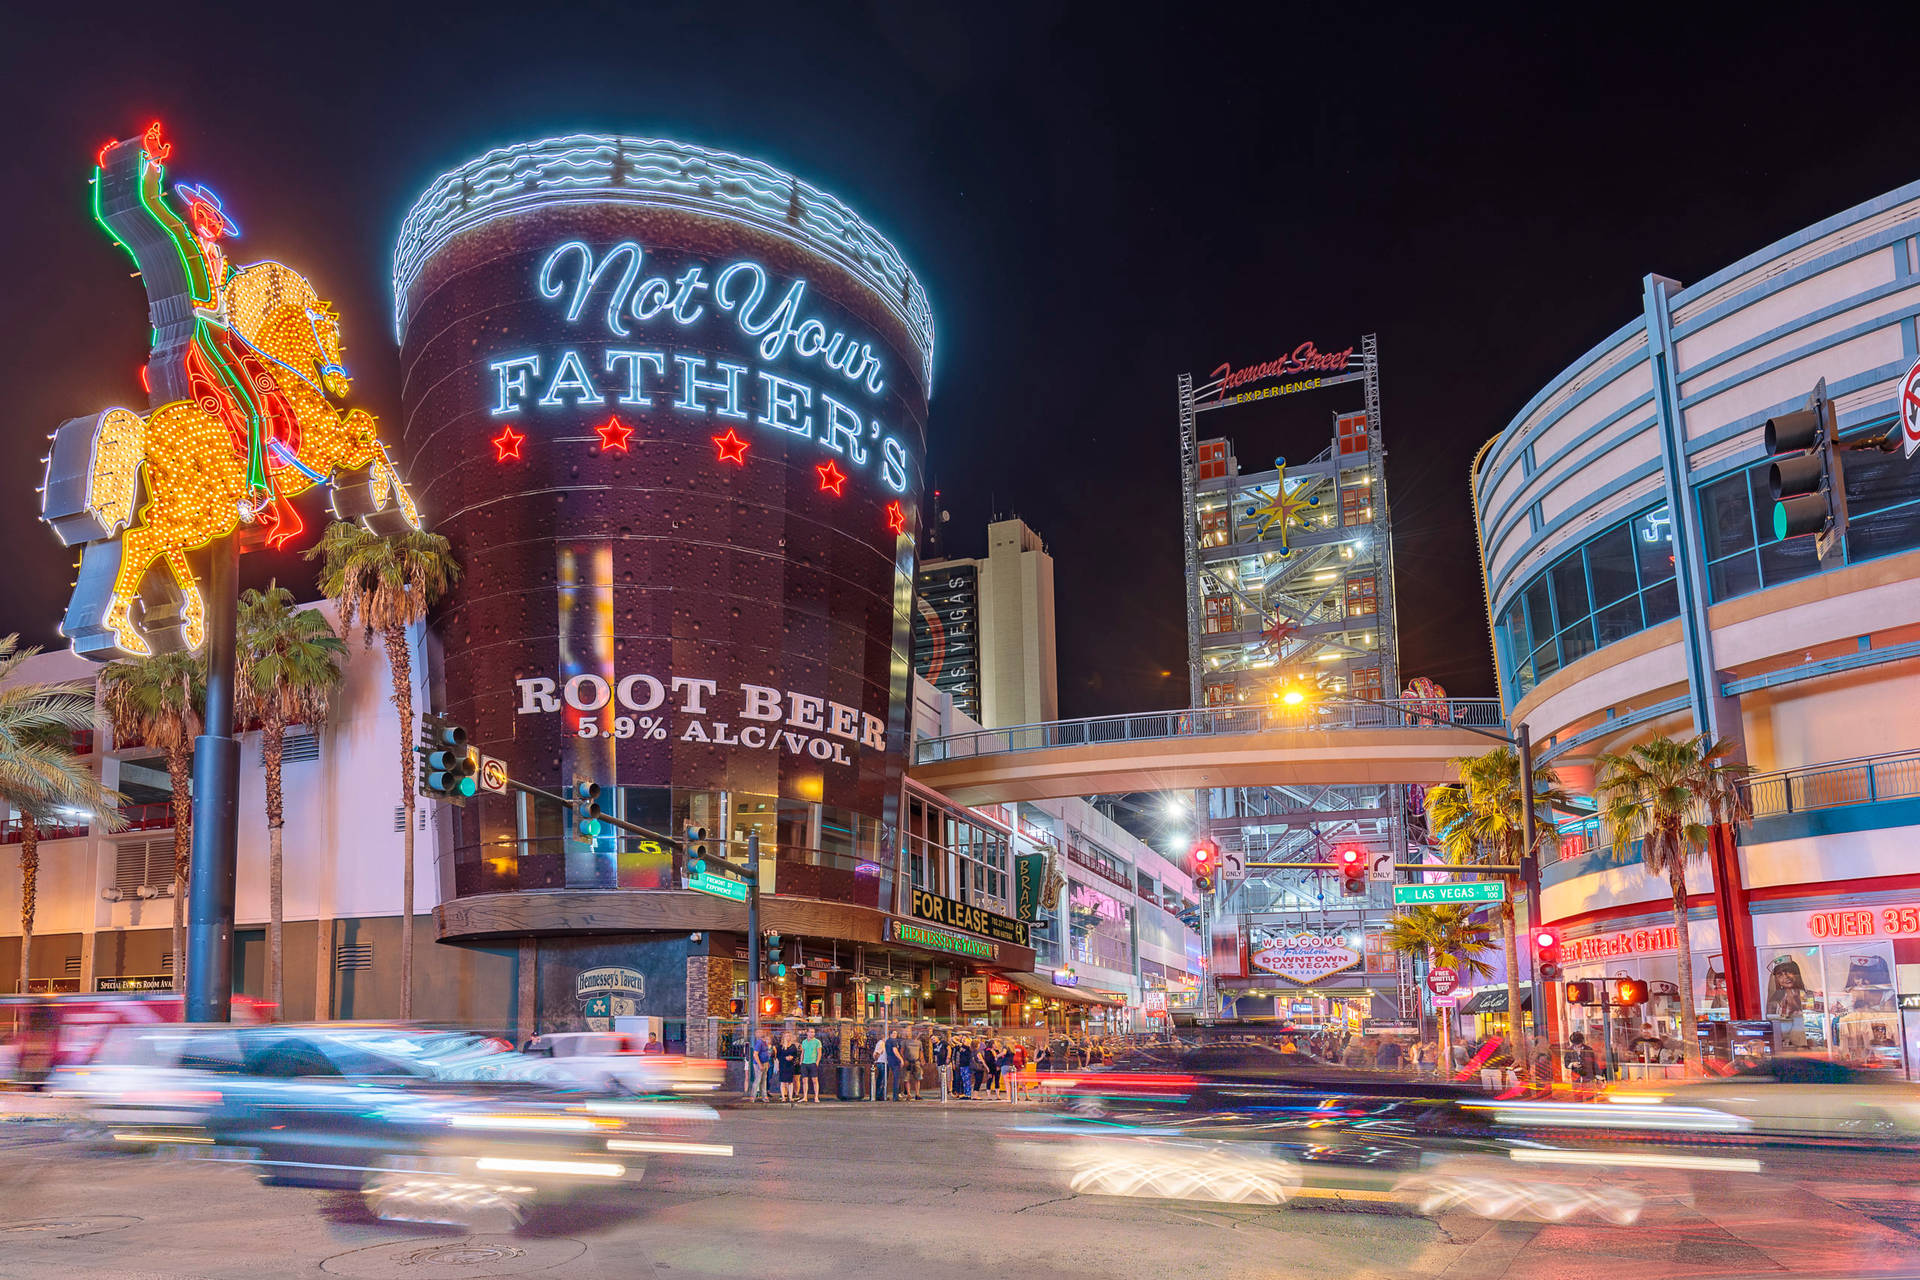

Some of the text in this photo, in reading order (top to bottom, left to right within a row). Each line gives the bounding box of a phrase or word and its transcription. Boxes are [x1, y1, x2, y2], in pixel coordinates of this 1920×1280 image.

[538, 241, 884, 394] Not Your
[1209, 341, 1353, 400] Fremont Street
[1236, 377, 1321, 404] EXPERIENCE
[490, 349, 908, 493] FATHER'S
[949, 577, 967, 708] LAS VEGAS
[516, 674, 887, 752] ROOT BEER
[577, 716, 851, 767] 5.9% ALC/VOL
[1225, 870, 1242, 878] ONLY
[1372, 871, 1391, 879] ONLY
[705, 883, 732, 895] EXPERIENCE
[1020, 860, 1031, 920] BRASS
[1415, 887, 1474, 900] LAS VEGAS
[912, 889, 989, 934] FOR LEASE
[1811, 908, 1920, 937] OVER 35
[901, 924, 962, 952] HENNESSEY'S
[1263, 936, 1346, 947] WELCOME
[1284, 947, 1329, 957] Fabulous
[1559, 941, 1581, 963] eart
[1581, 933, 1632, 960] Attack
[1262, 955, 1348, 964] DOWNTOWN
[101, 980, 173, 989] SPECIAL EVENTS ROOM AVA
[579, 970, 643, 990] Hennessey's Tavern
